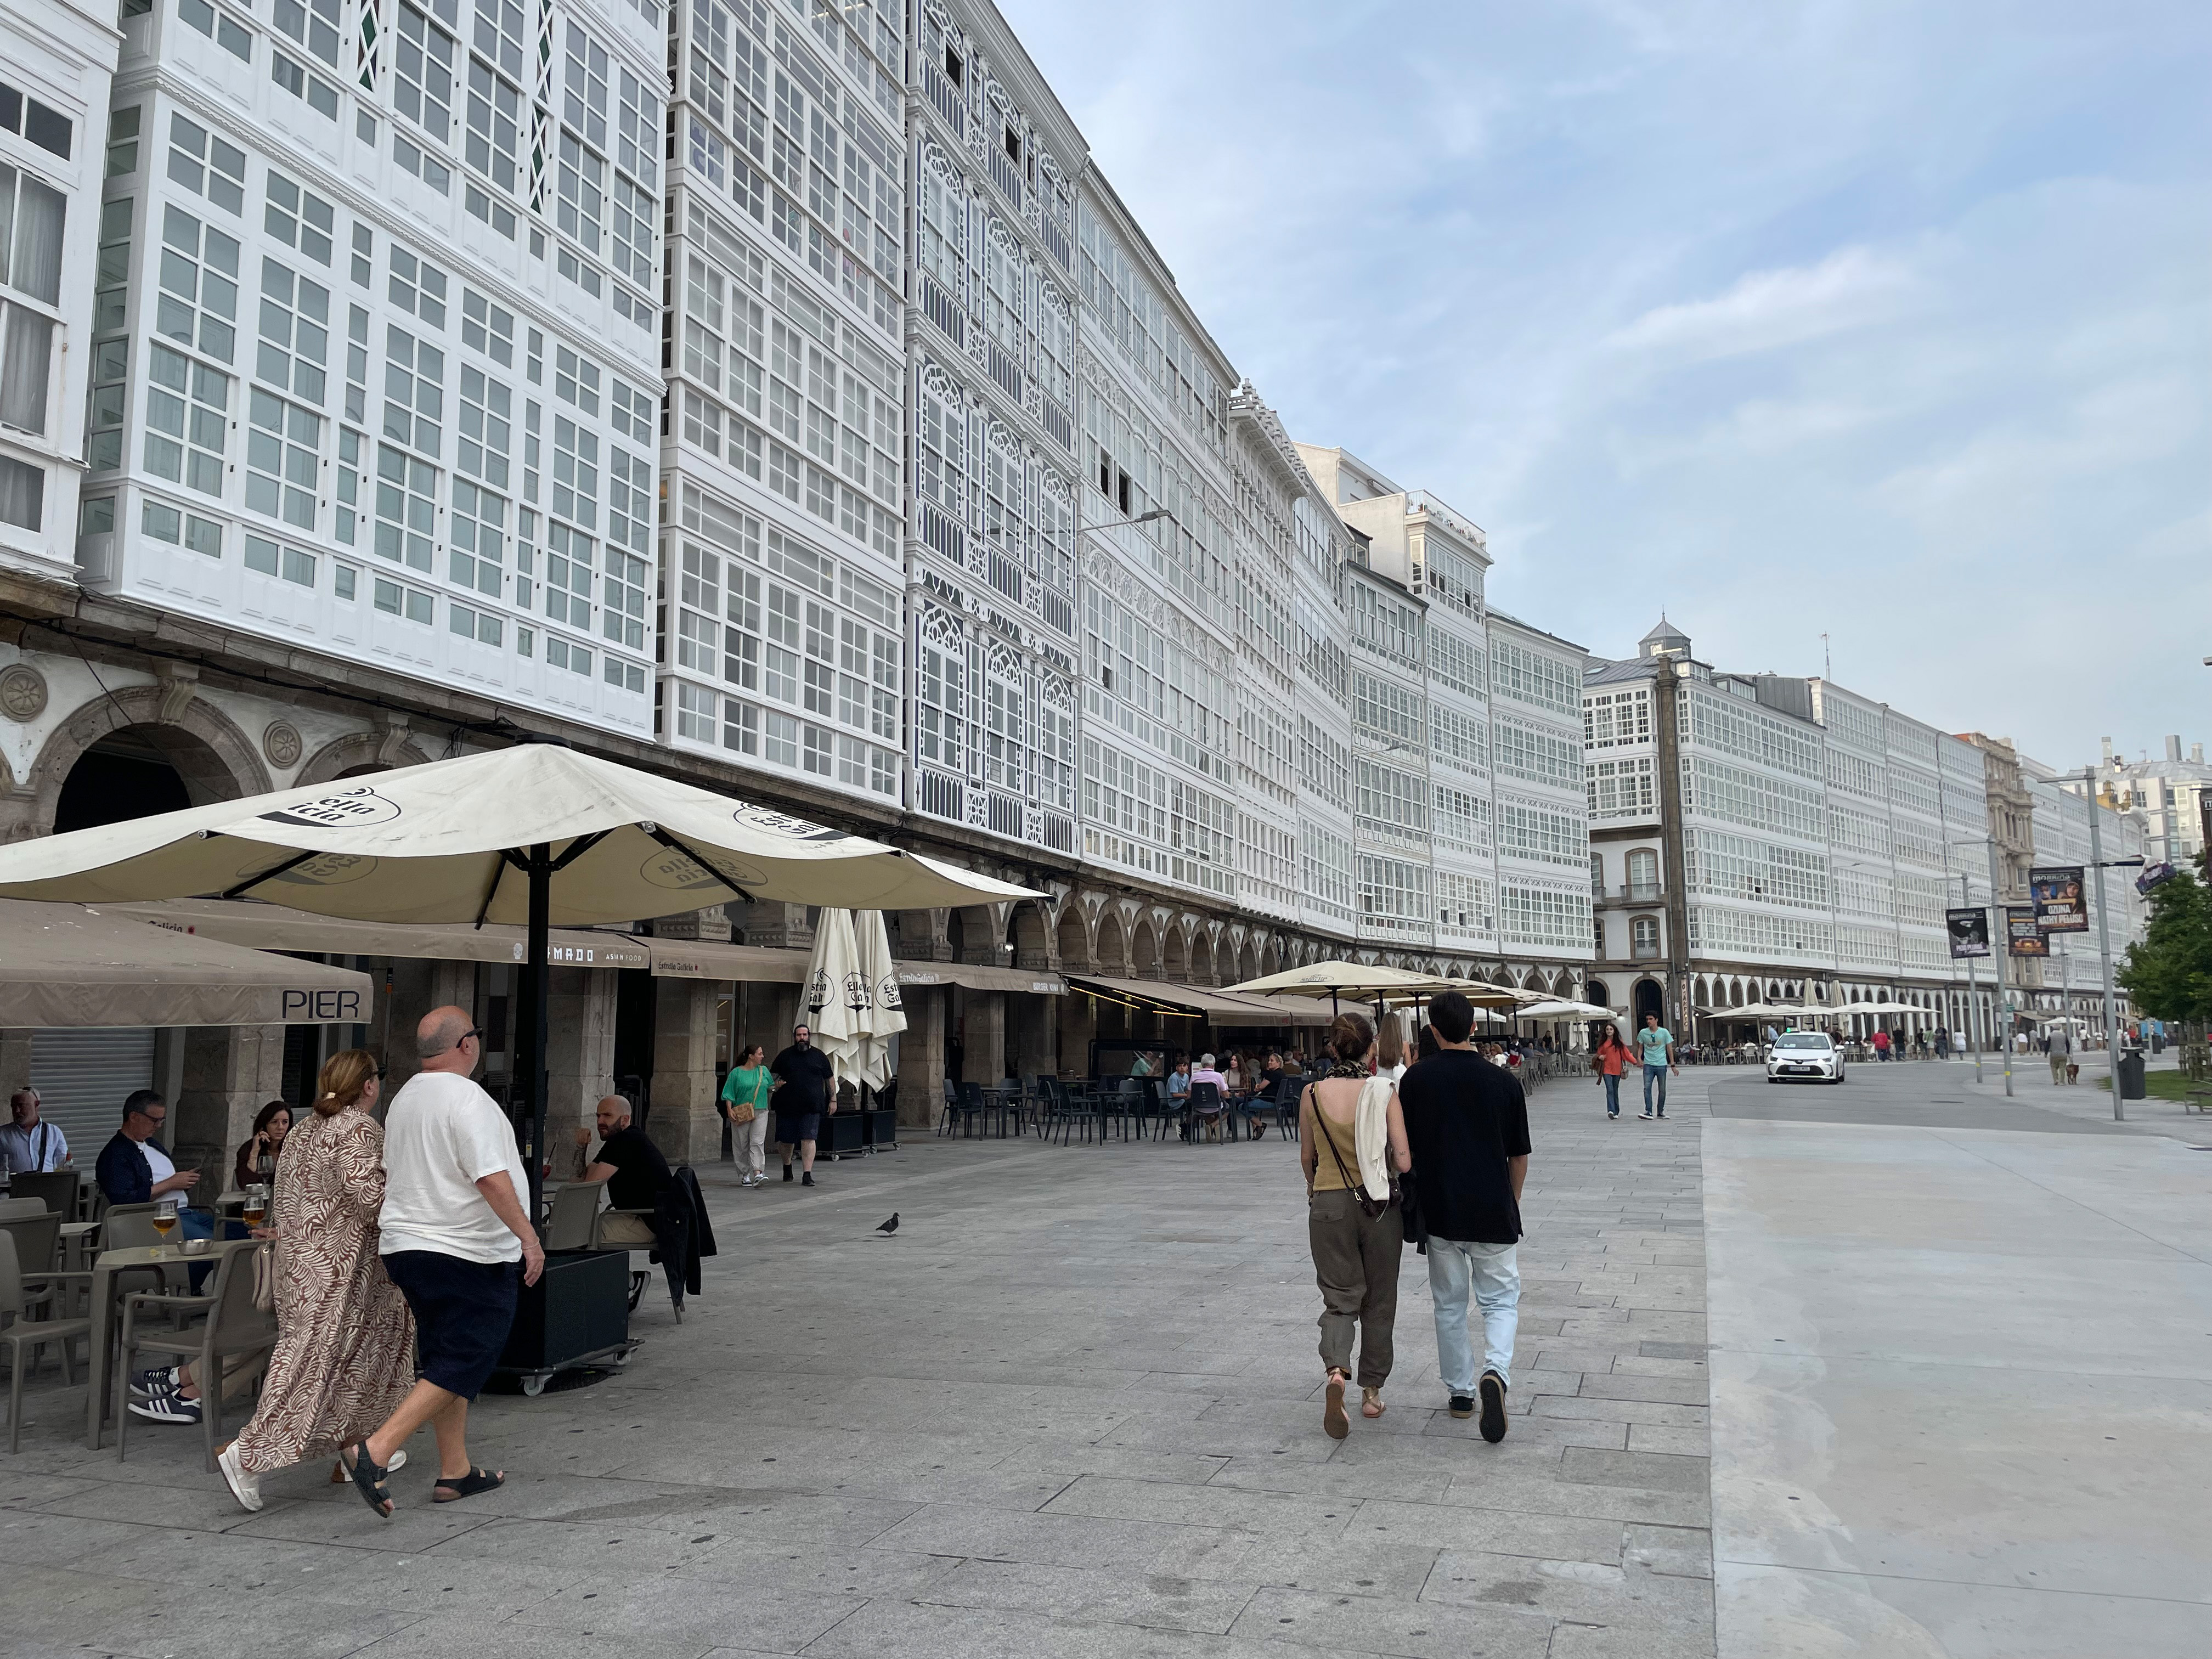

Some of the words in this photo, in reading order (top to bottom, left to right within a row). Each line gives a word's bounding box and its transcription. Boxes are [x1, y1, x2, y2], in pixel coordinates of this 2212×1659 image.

[287, 802, 346, 821] icia
[318, 797, 376, 814] ella
[778, 821, 825, 833] Gal
[2048, 904, 2071, 915] OZUNA
[2038, 915, 2057, 925] NATHY
[2059, 914, 2083, 924] PELUSO
[548, 946, 593, 962] MADO
[658, 961, 676, 970] Estrella
[677, 963, 693, 971] Galicia
[1033, 982, 1048, 991] BURGER
[282, 990, 359, 1019] PIER
